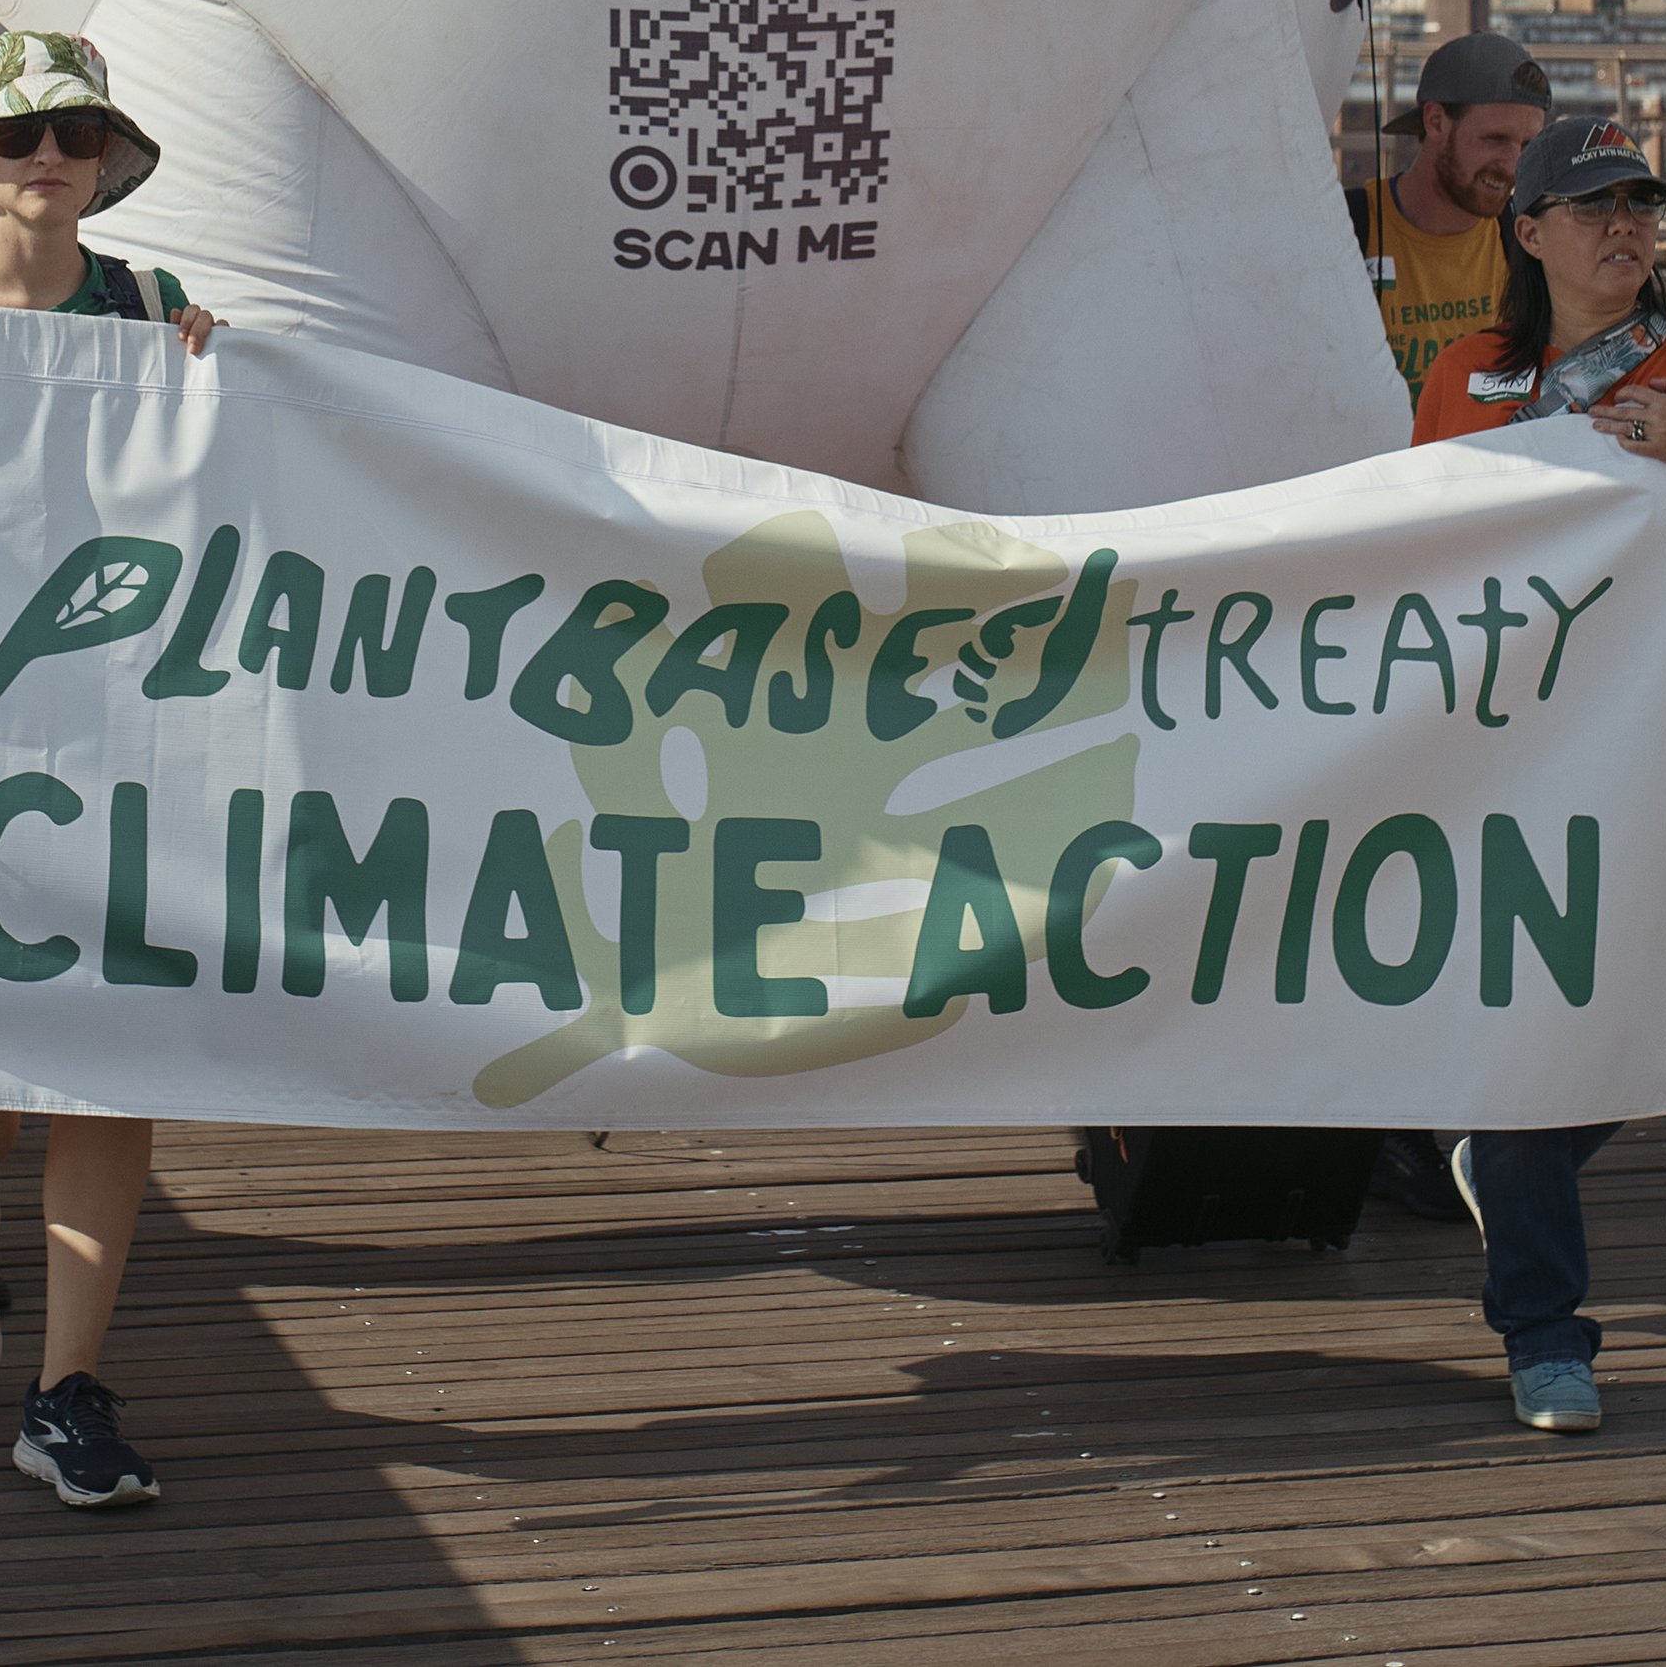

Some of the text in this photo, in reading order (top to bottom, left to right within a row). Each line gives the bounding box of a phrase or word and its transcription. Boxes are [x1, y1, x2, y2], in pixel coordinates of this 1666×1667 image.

[1571, 148, 1598, 166] ROCKY
[613, 220, 878, 271] SCAN ME
[1390, 295, 1493, 325] I ENDORSE
[1481, 374, 1529, 392] SAM
[510, 548, 1120, 747] BASED
[902, 814, 1601, 1019] ACTION
